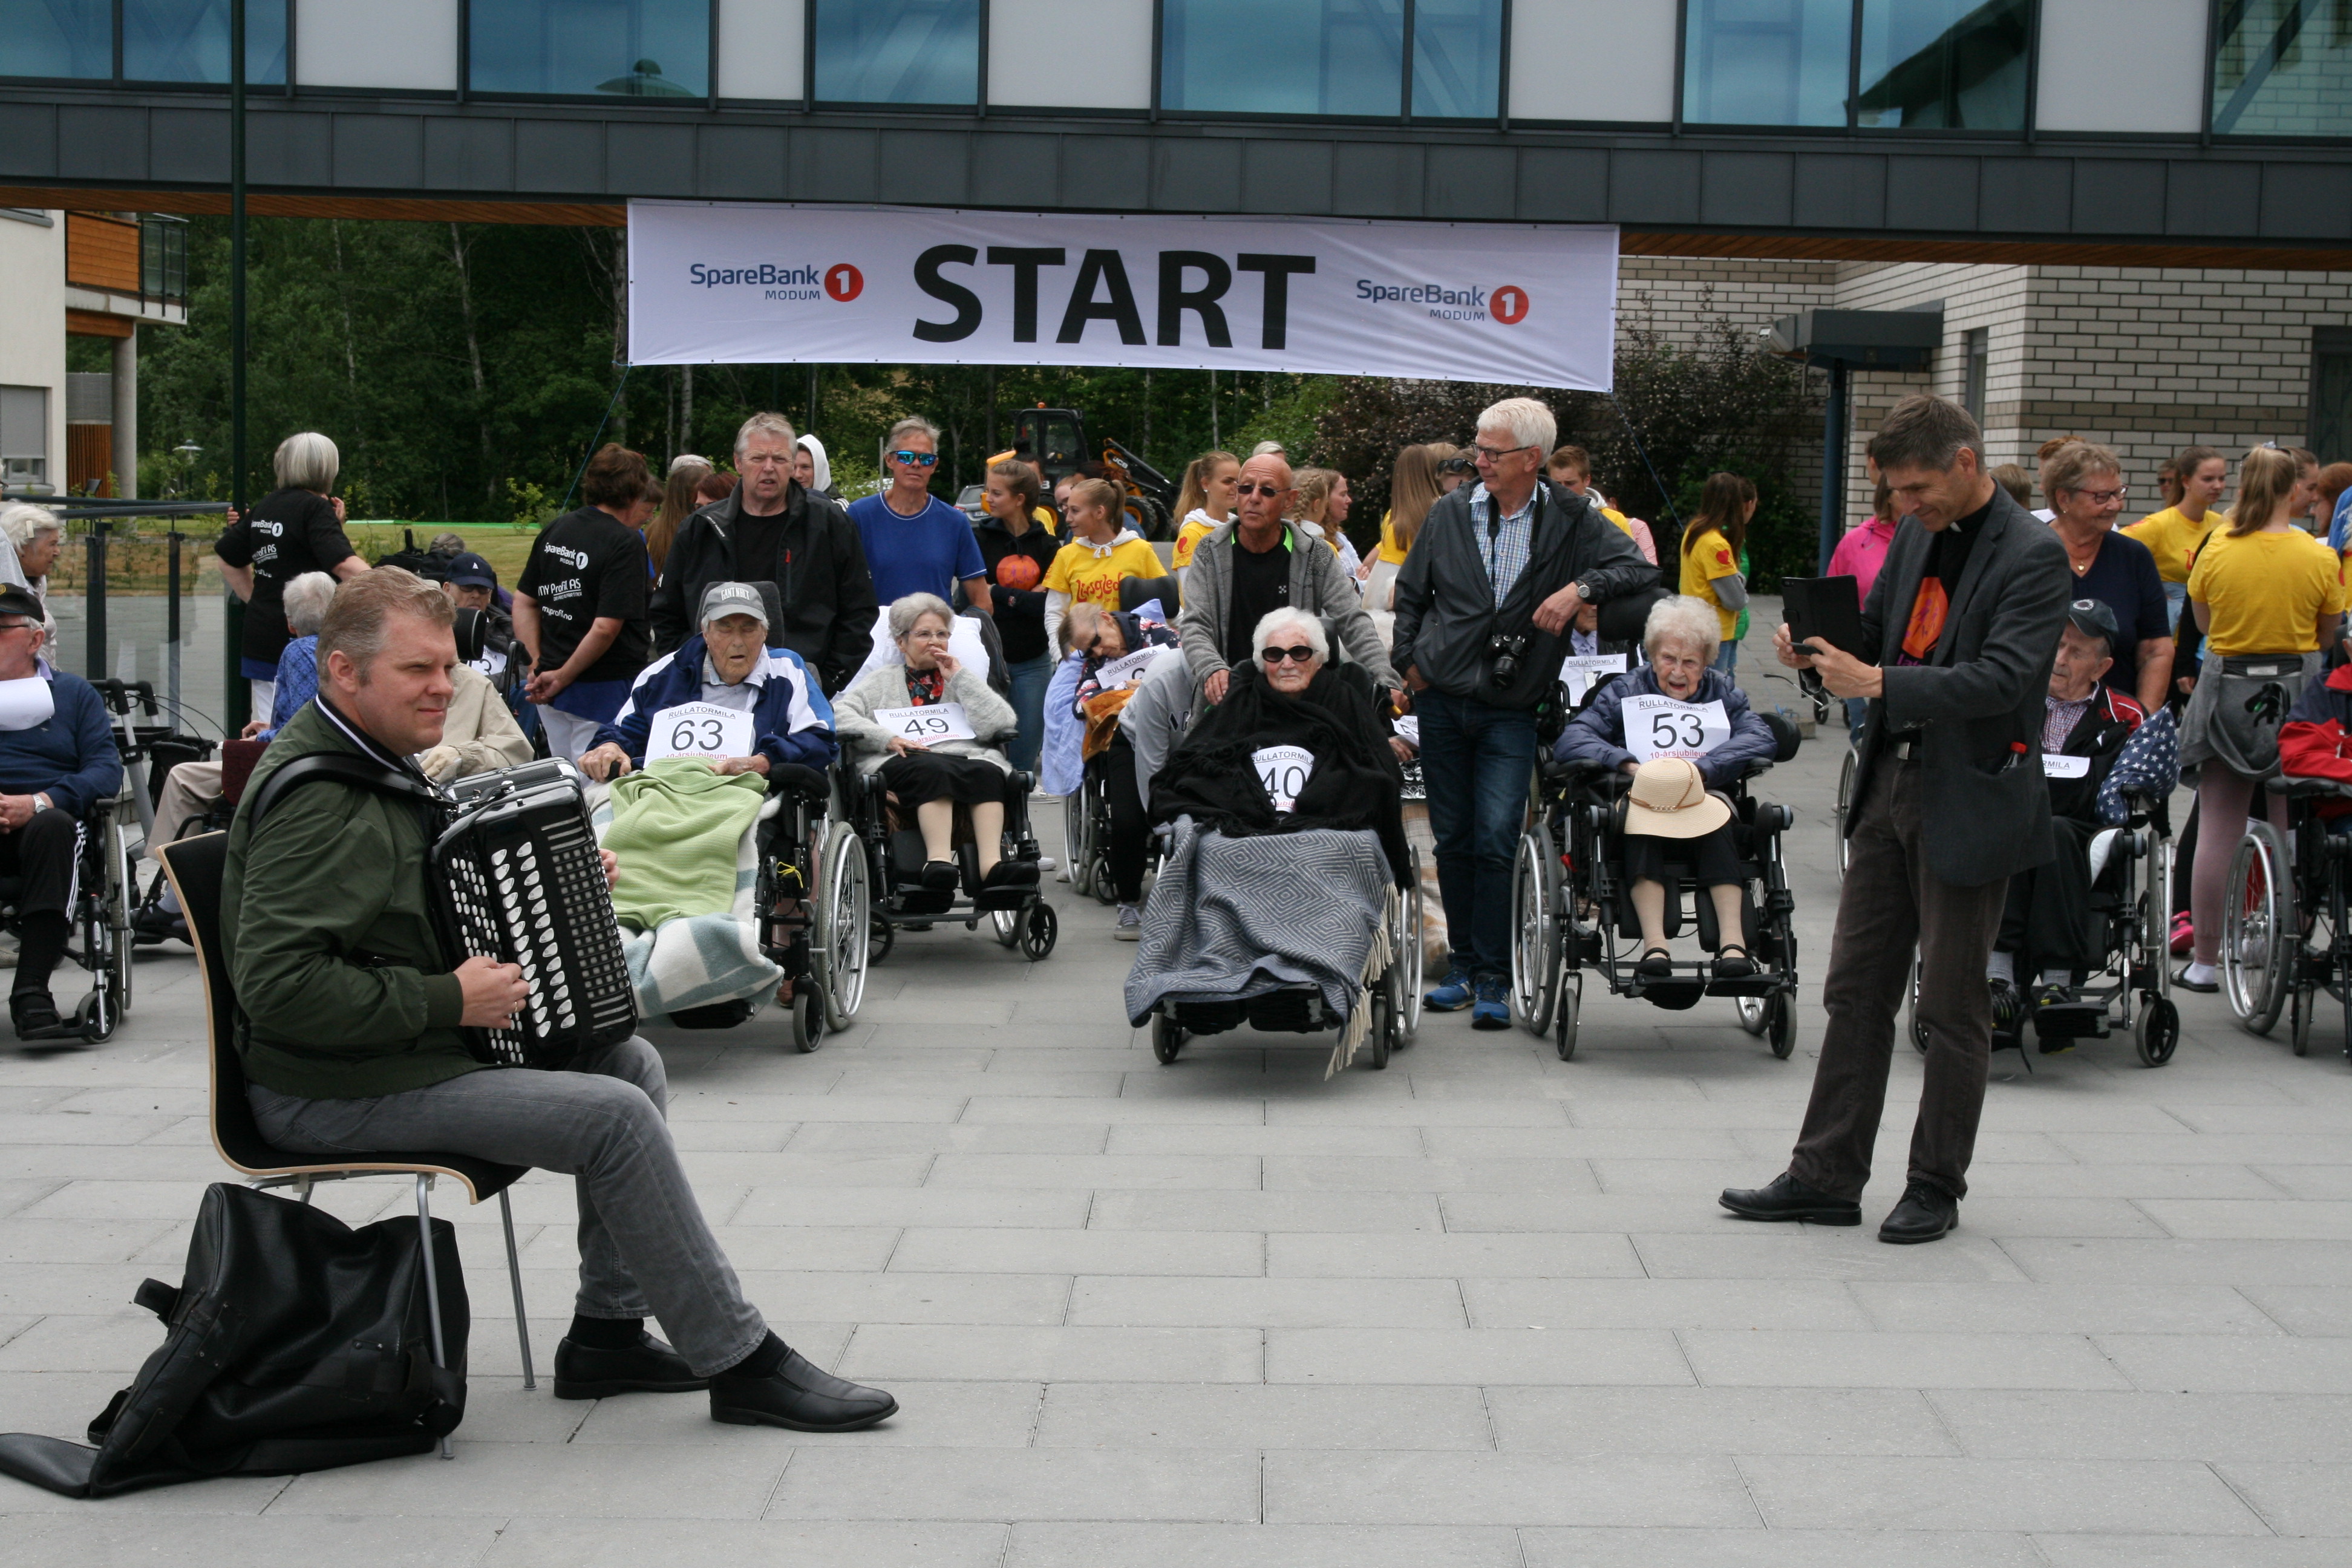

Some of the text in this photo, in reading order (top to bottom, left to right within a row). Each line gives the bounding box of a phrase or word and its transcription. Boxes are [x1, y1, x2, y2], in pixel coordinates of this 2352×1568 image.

[690, 263, 850, 295] SpareBank 1
[765, 290, 821, 300] MODUM
[912, 244, 1316, 350] START
[1356, 279, 1516, 318] SpareBank 1
[1429, 309, 1485, 321] MODUM
[1112, 457, 1128, 469] JCB
[267, 544, 276, 554] AS
[544, 542, 577, 560] SpareBank
[538, 578, 581, 596] MY Profil AS
[1106, 649, 1158, 676] RULLATORMILA
[1568, 658, 1618, 667] RULLATORMILA
[668, 706, 736, 719] RULLATORMILA
[889, 708, 949, 718] RULLATORMILA
[1639, 699, 1708, 711] RULLATORMILA
[671, 719, 724, 751] 63
[904, 717, 950, 736] 49
[1652, 713, 1705, 749] 53
[1263, 766, 1307, 799] 40
